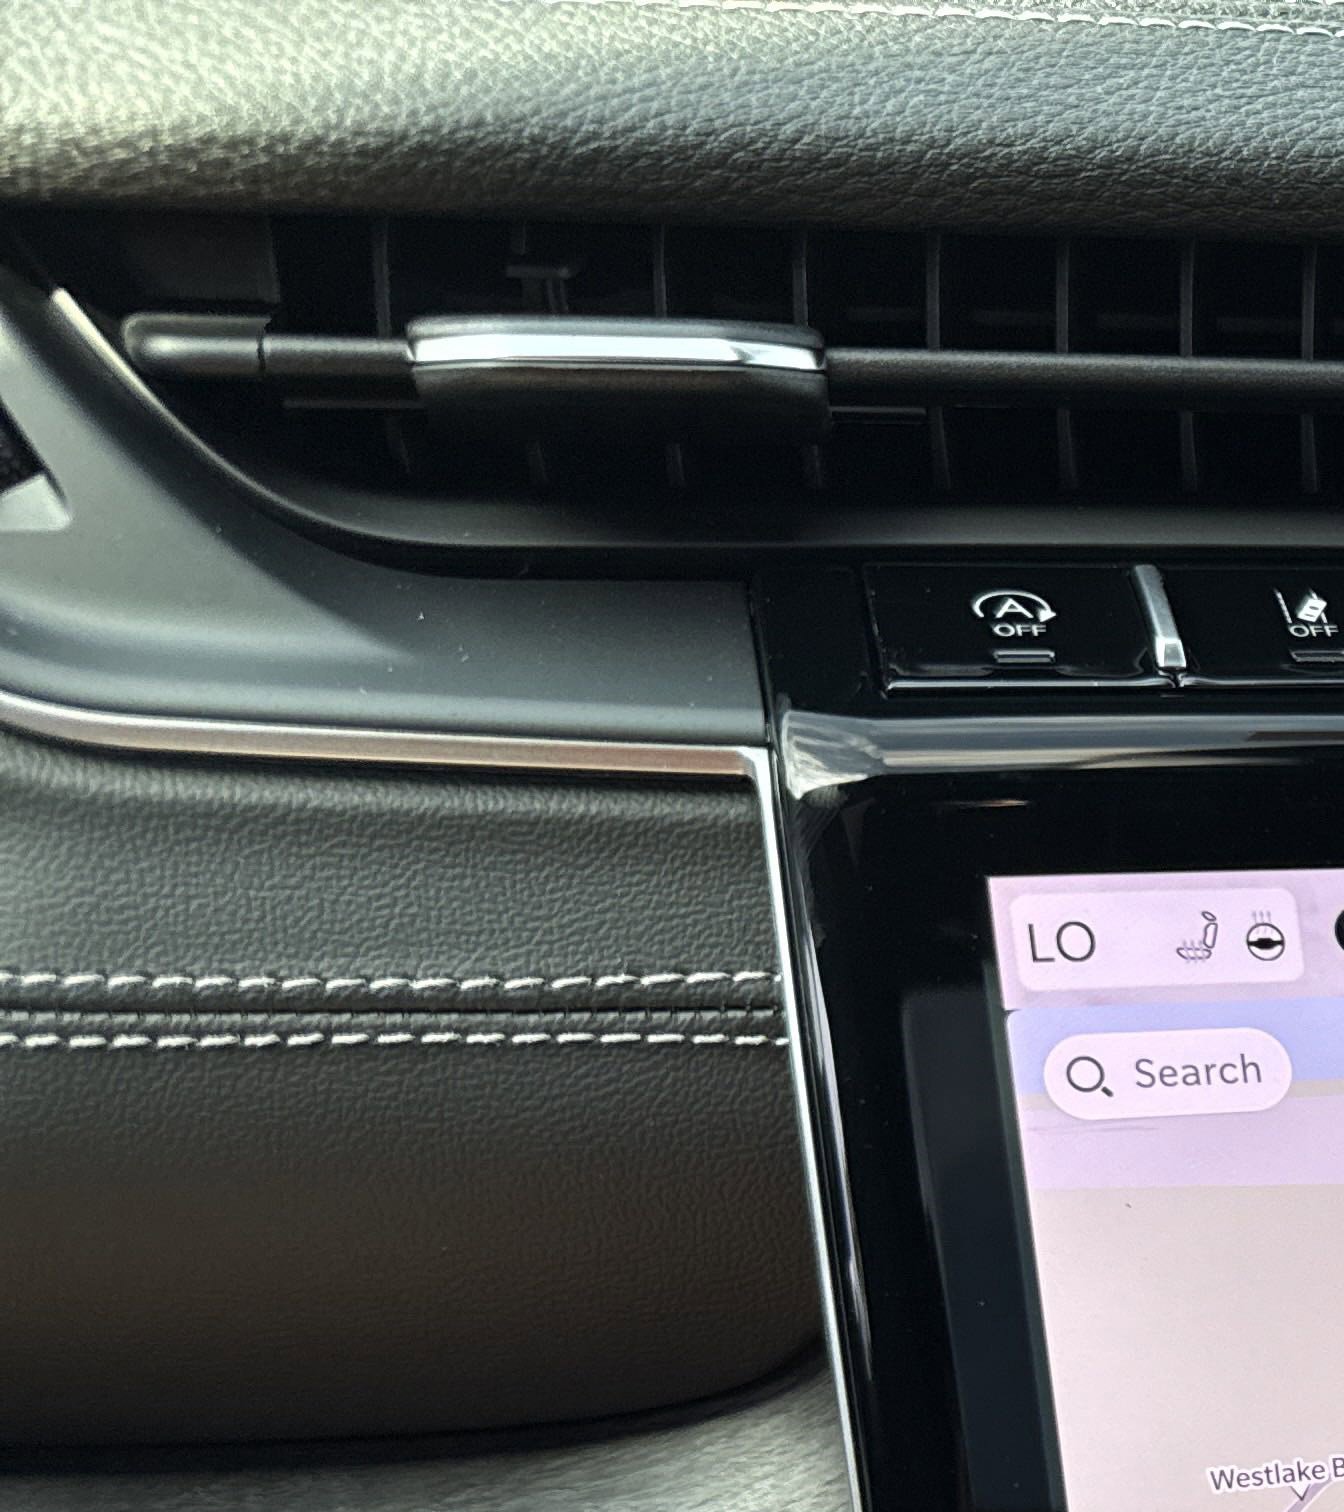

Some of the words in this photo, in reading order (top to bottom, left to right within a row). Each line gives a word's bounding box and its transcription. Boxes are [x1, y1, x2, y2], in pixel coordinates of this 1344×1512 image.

[993, 623, 1048, 638] OFF
[1288, 623, 1340, 638] OFF
[1027, 921, 1097, 963] LO
[1134, 1053, 1263, 1089] Search
[1209, 1460, 1327, 1493] Westlake
